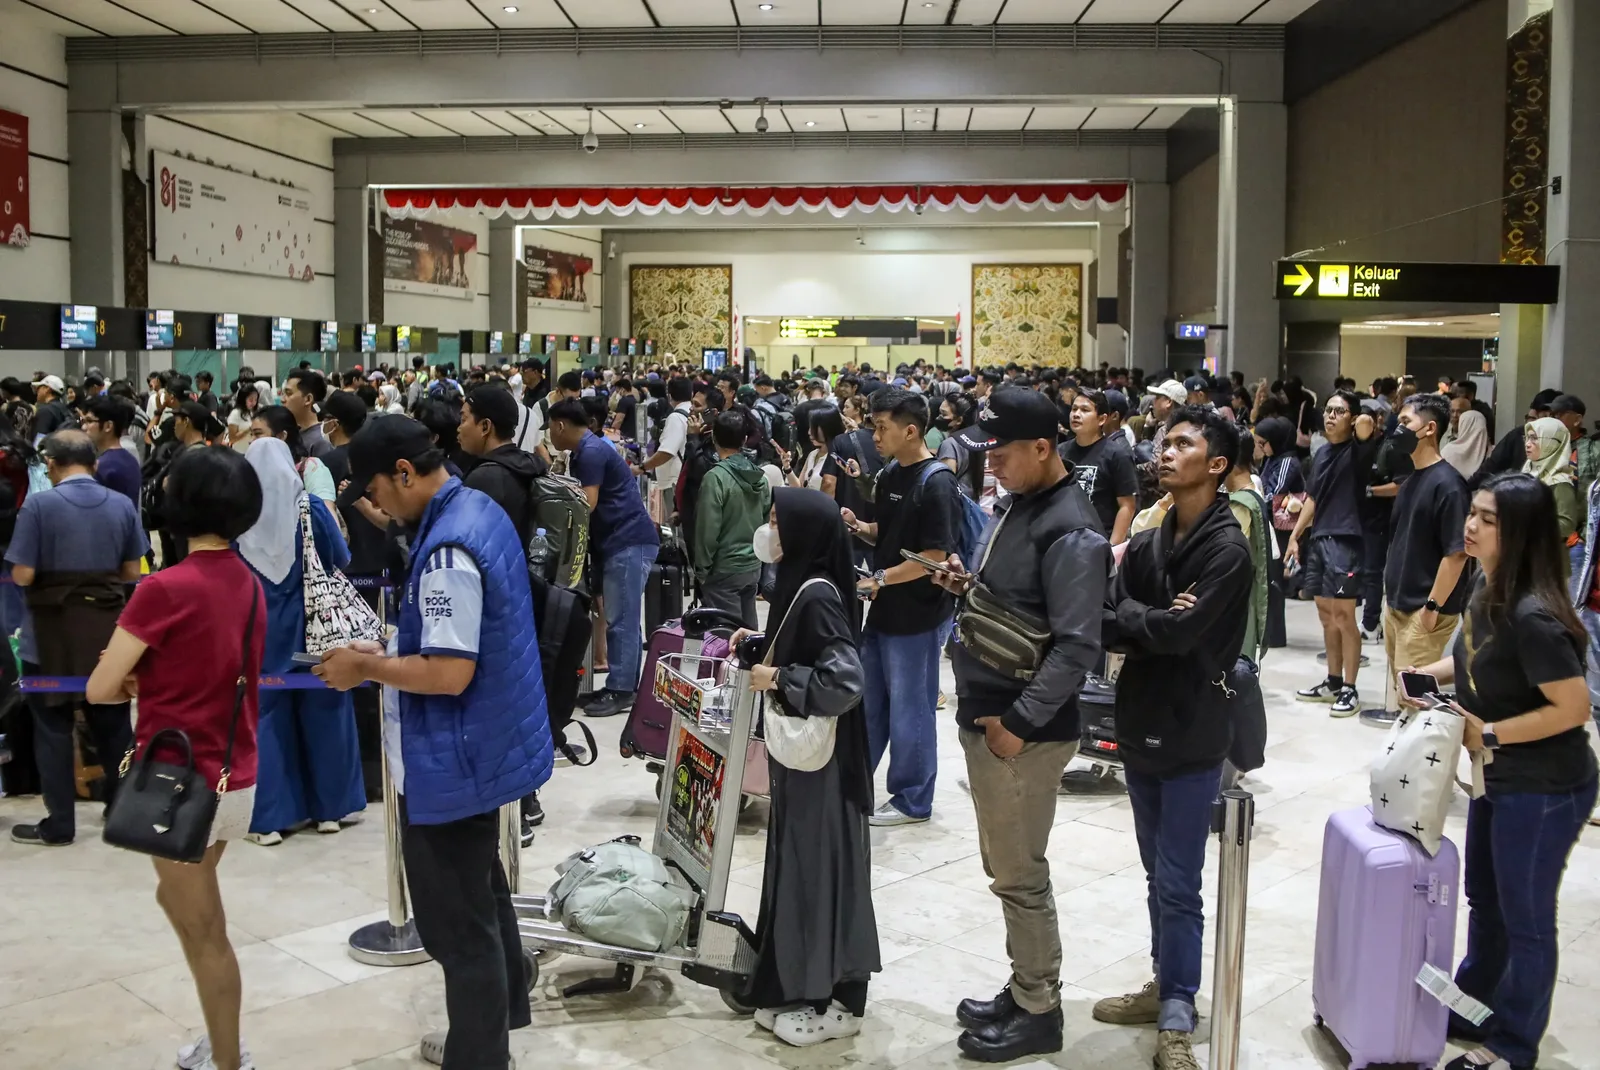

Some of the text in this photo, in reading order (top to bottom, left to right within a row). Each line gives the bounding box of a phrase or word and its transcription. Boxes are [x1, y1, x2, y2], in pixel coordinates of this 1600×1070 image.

[160, 166, 177, 213] 81
[1354, 265, 1401, 280] Keluar
[1353, 282, 1380, 297] Exit
[959, 433, 988, 448] SECURITY
[352, 578, 374, 586] BOOK
[425, 596, 452, 607] ROCK
[425, 607, 453, 617] STARS
